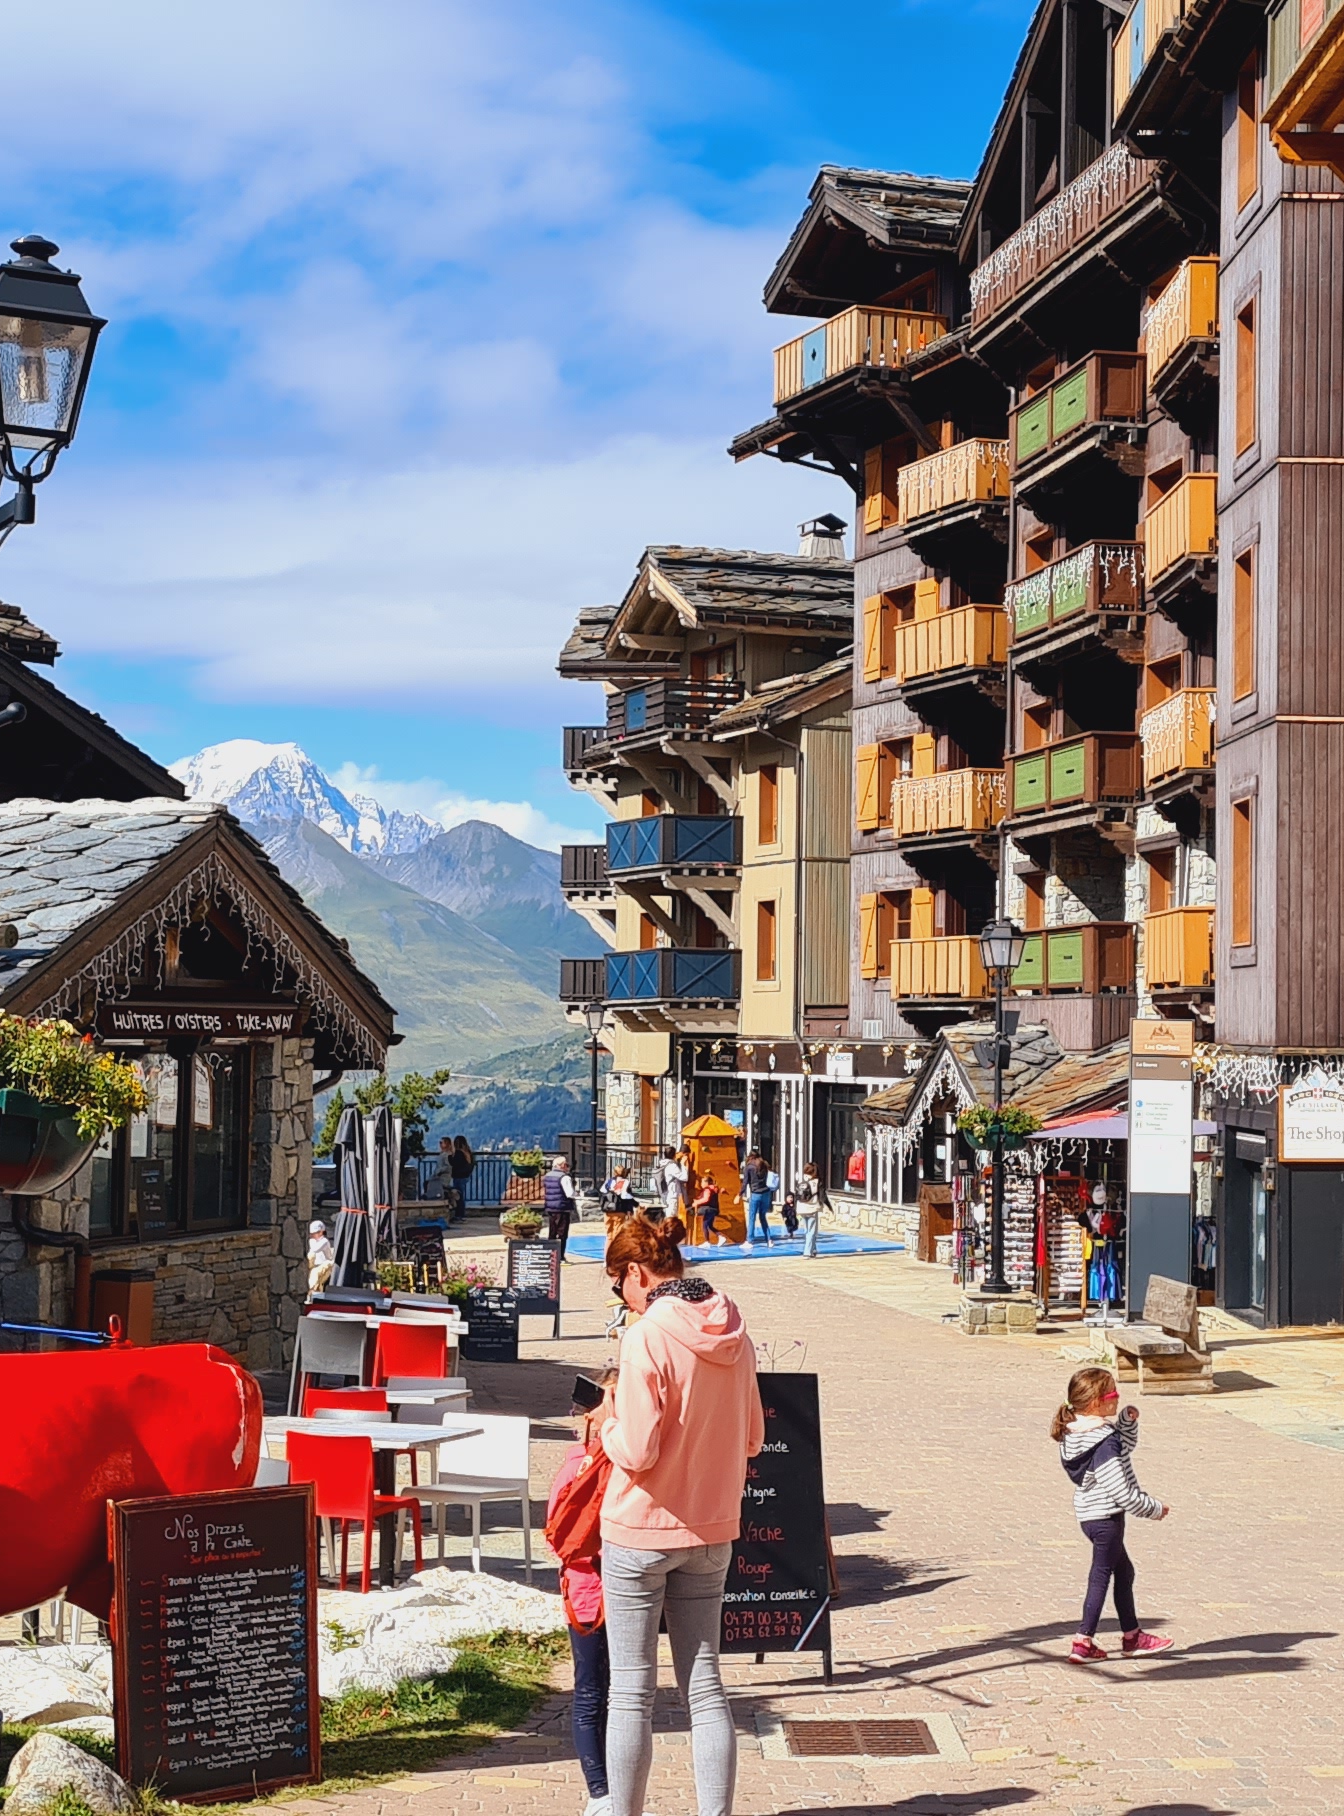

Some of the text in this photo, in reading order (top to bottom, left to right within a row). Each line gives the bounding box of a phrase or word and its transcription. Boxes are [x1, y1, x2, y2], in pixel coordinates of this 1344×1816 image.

[175, 1012, 222, 1033] OYSTERS
[236, 1013, 294, 1032] TAKE-AWAY
[1287, 1127, 1313, 1140] The
[761, 1440, 790, 1452] ande
[742, 1484, 777, 1505] ntagne
[165, 1514, 199, 1541] Nos
[741, 1521, 785, 1542] Vache
[206, 1537, 216, 1551] la
[737, 1556, 774, 1583] Rouge
[724, 1611, 739, 1625] 04
[741, 1611, 755, 1625] 79
[758, 1612, 771, 1624] 00
[791, 1611, 803, 1625] 74
[758, 1626, 770, 1637] 62
[774, 1626, 785, 1636] 99
